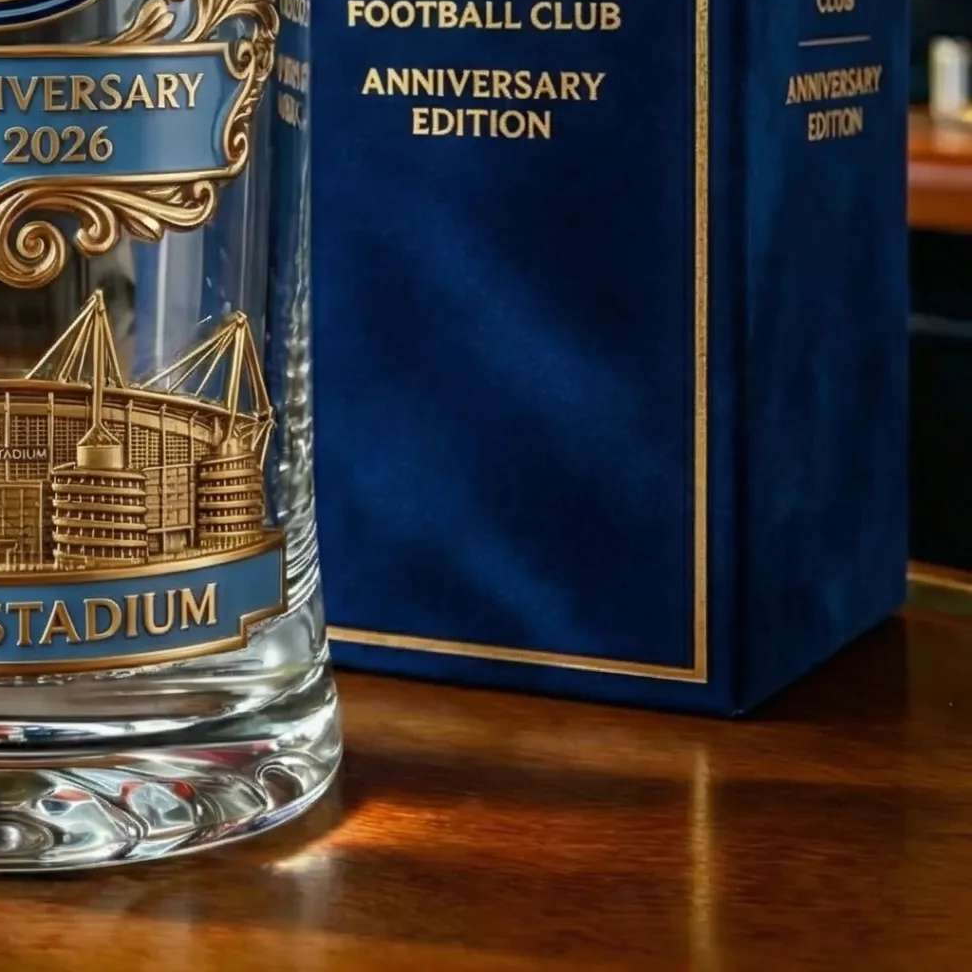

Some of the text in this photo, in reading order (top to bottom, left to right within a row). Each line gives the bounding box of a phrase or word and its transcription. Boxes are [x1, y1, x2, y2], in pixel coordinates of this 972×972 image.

[347, 0, 622, 31] FOOTBALL CLUB
[361, 67, 606, 101] ANNIVERSARY
[785, 65, 883, 105] ANNIVERSARY
[411, 107, 551, 140] EDITION
[808, 106, 864, 142] EDITION
[2, 124, 113, 164] 2026
